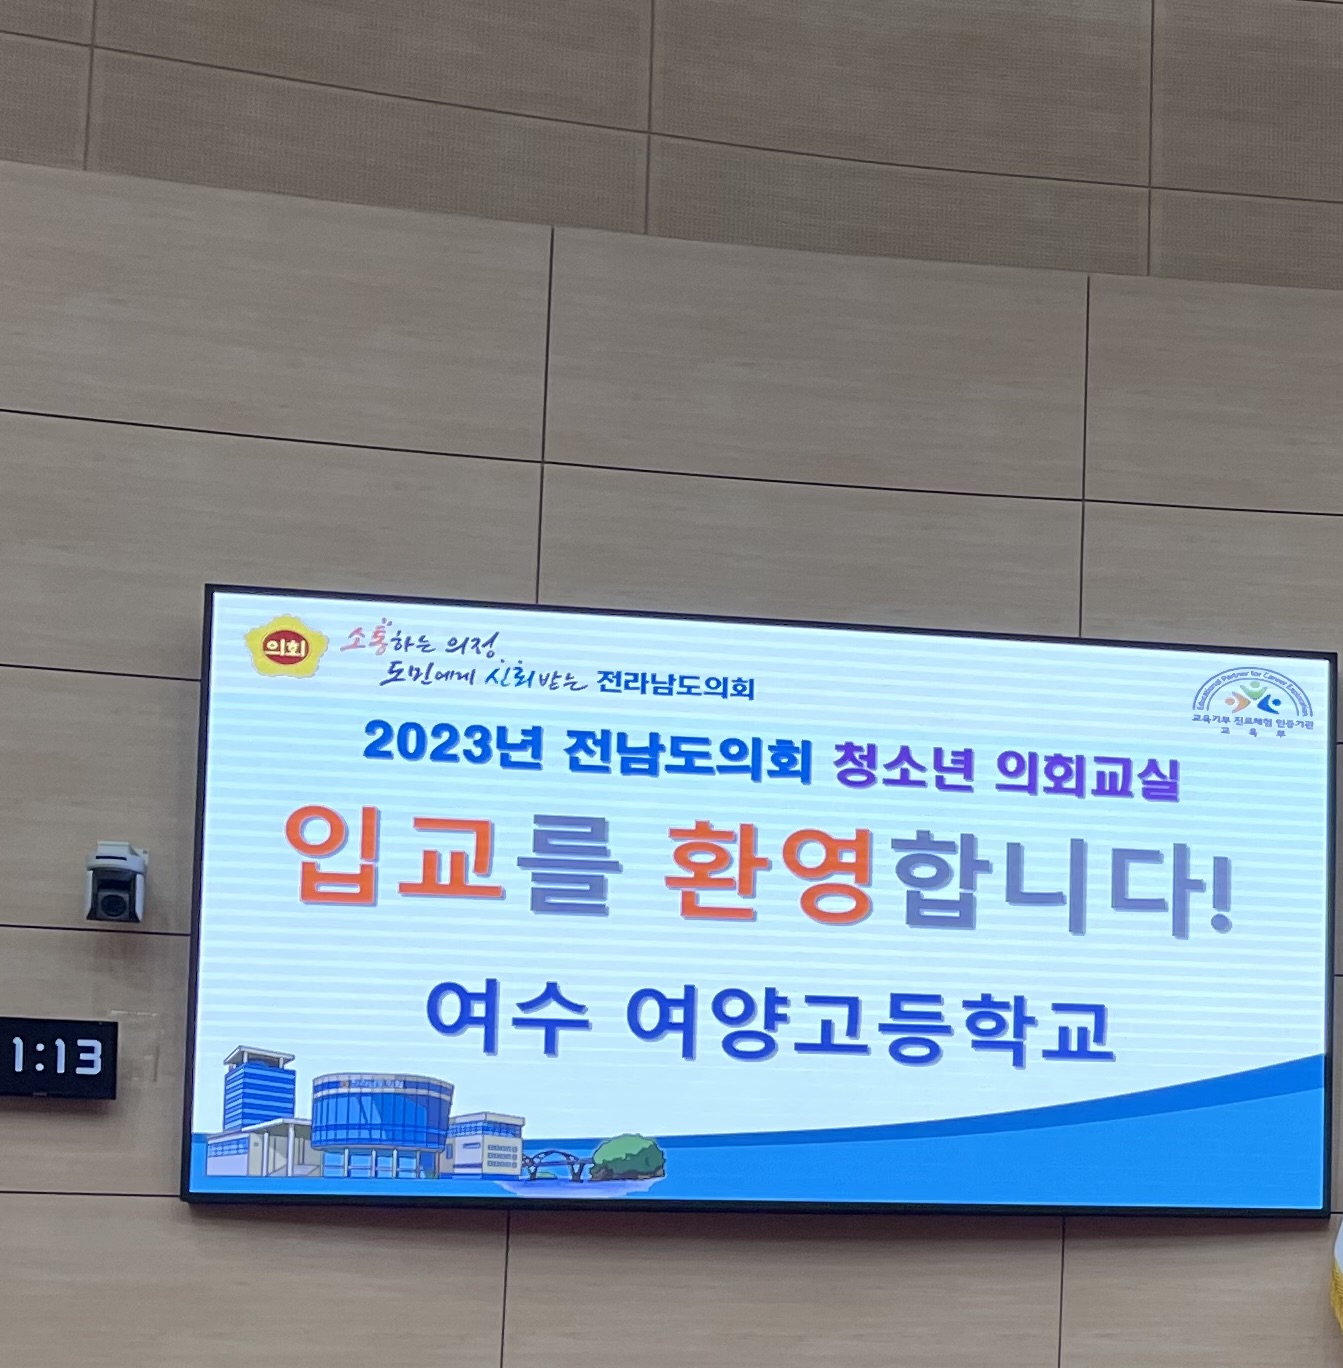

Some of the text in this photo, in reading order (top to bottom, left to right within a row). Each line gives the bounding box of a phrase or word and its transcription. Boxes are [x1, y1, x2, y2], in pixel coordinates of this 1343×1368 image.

[265, 638, 307, 658] 의회
[339, 617, 501, 659] 소통하는 의정
[379, 658, 756, 702] 도민에게 신뢰받는 전라남도의회
[362, 718, 1182, 803] 2023년 전남도의회 청소년 의회교실
[284, 803, 1233, 940] 입교를 환영합니다!
[426, 977, 1117, 1070] 여수 여양고등학교
[12, 1036, 103, 1075] 1:13
